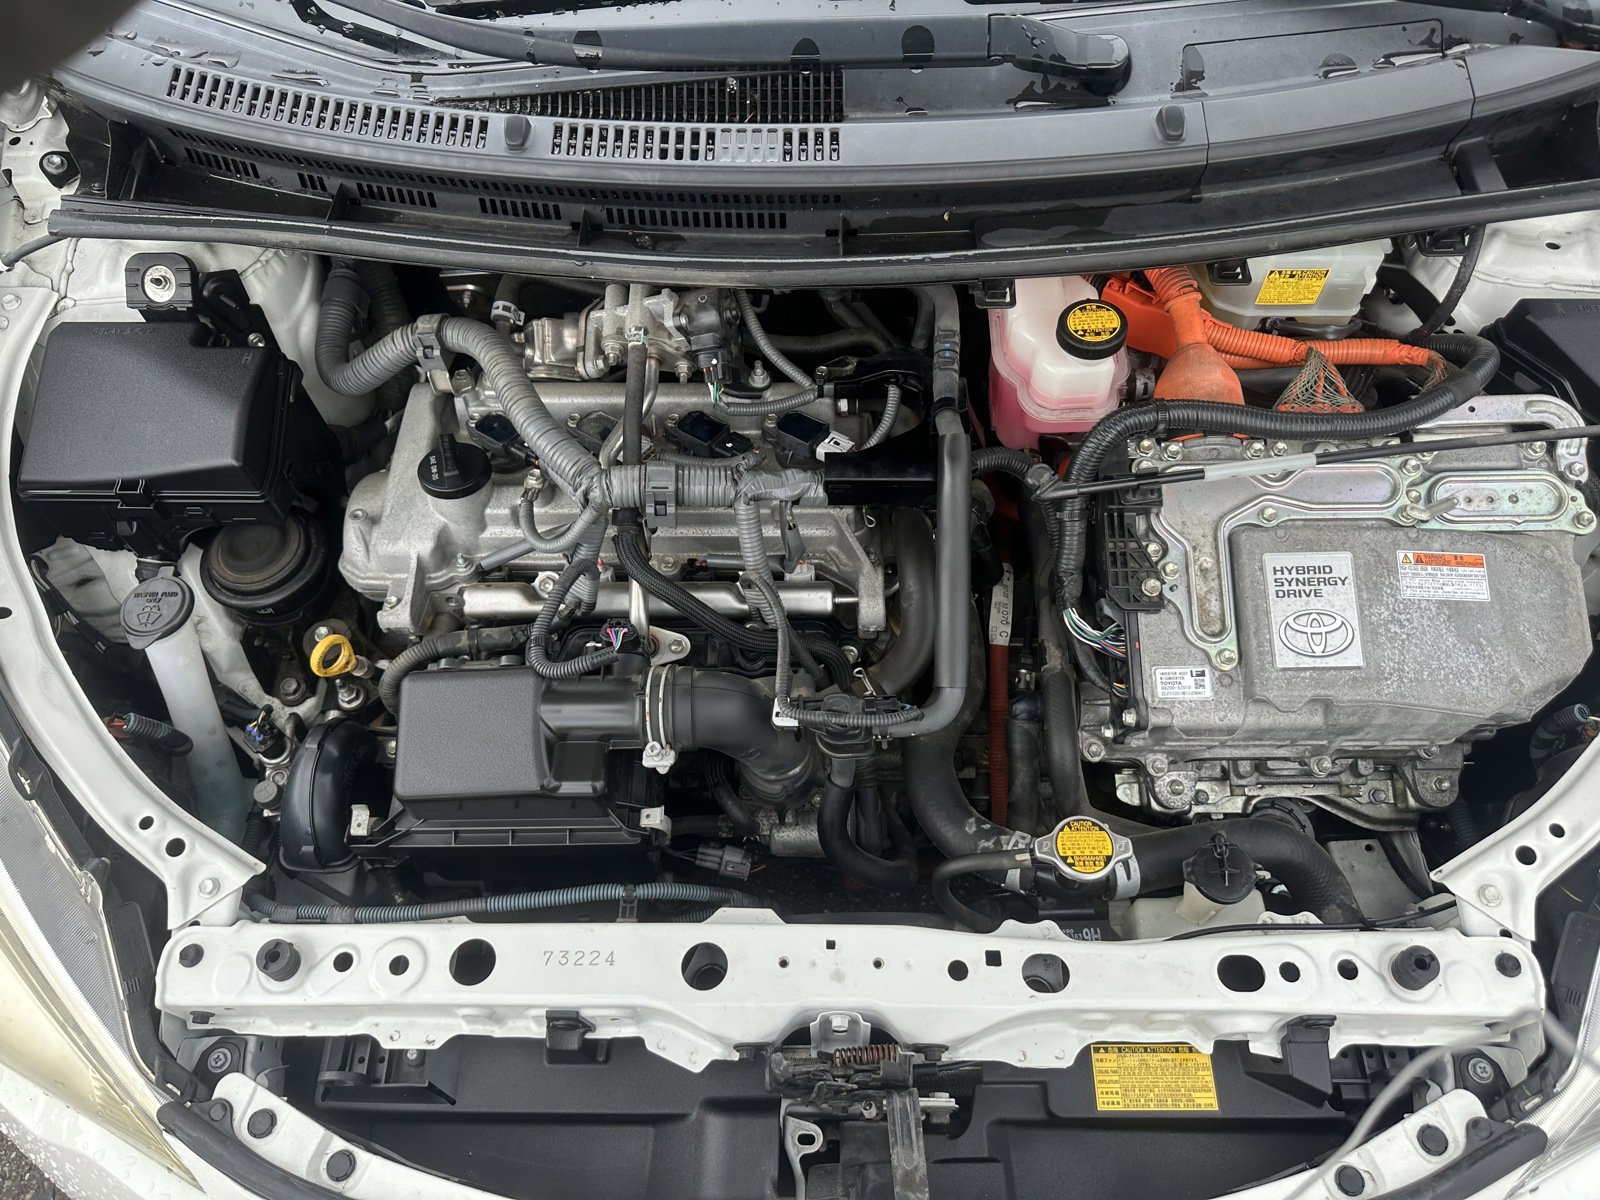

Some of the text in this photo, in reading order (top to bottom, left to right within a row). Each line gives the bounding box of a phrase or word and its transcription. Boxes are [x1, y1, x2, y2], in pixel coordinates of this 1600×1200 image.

[1272, 565, 1333, 576] HYBRID
[1273, 576, 1349, 588] SYNERGY
[1275, 588, 1324, 599] DRIVE
[543, 950, 616, 966] 73224
